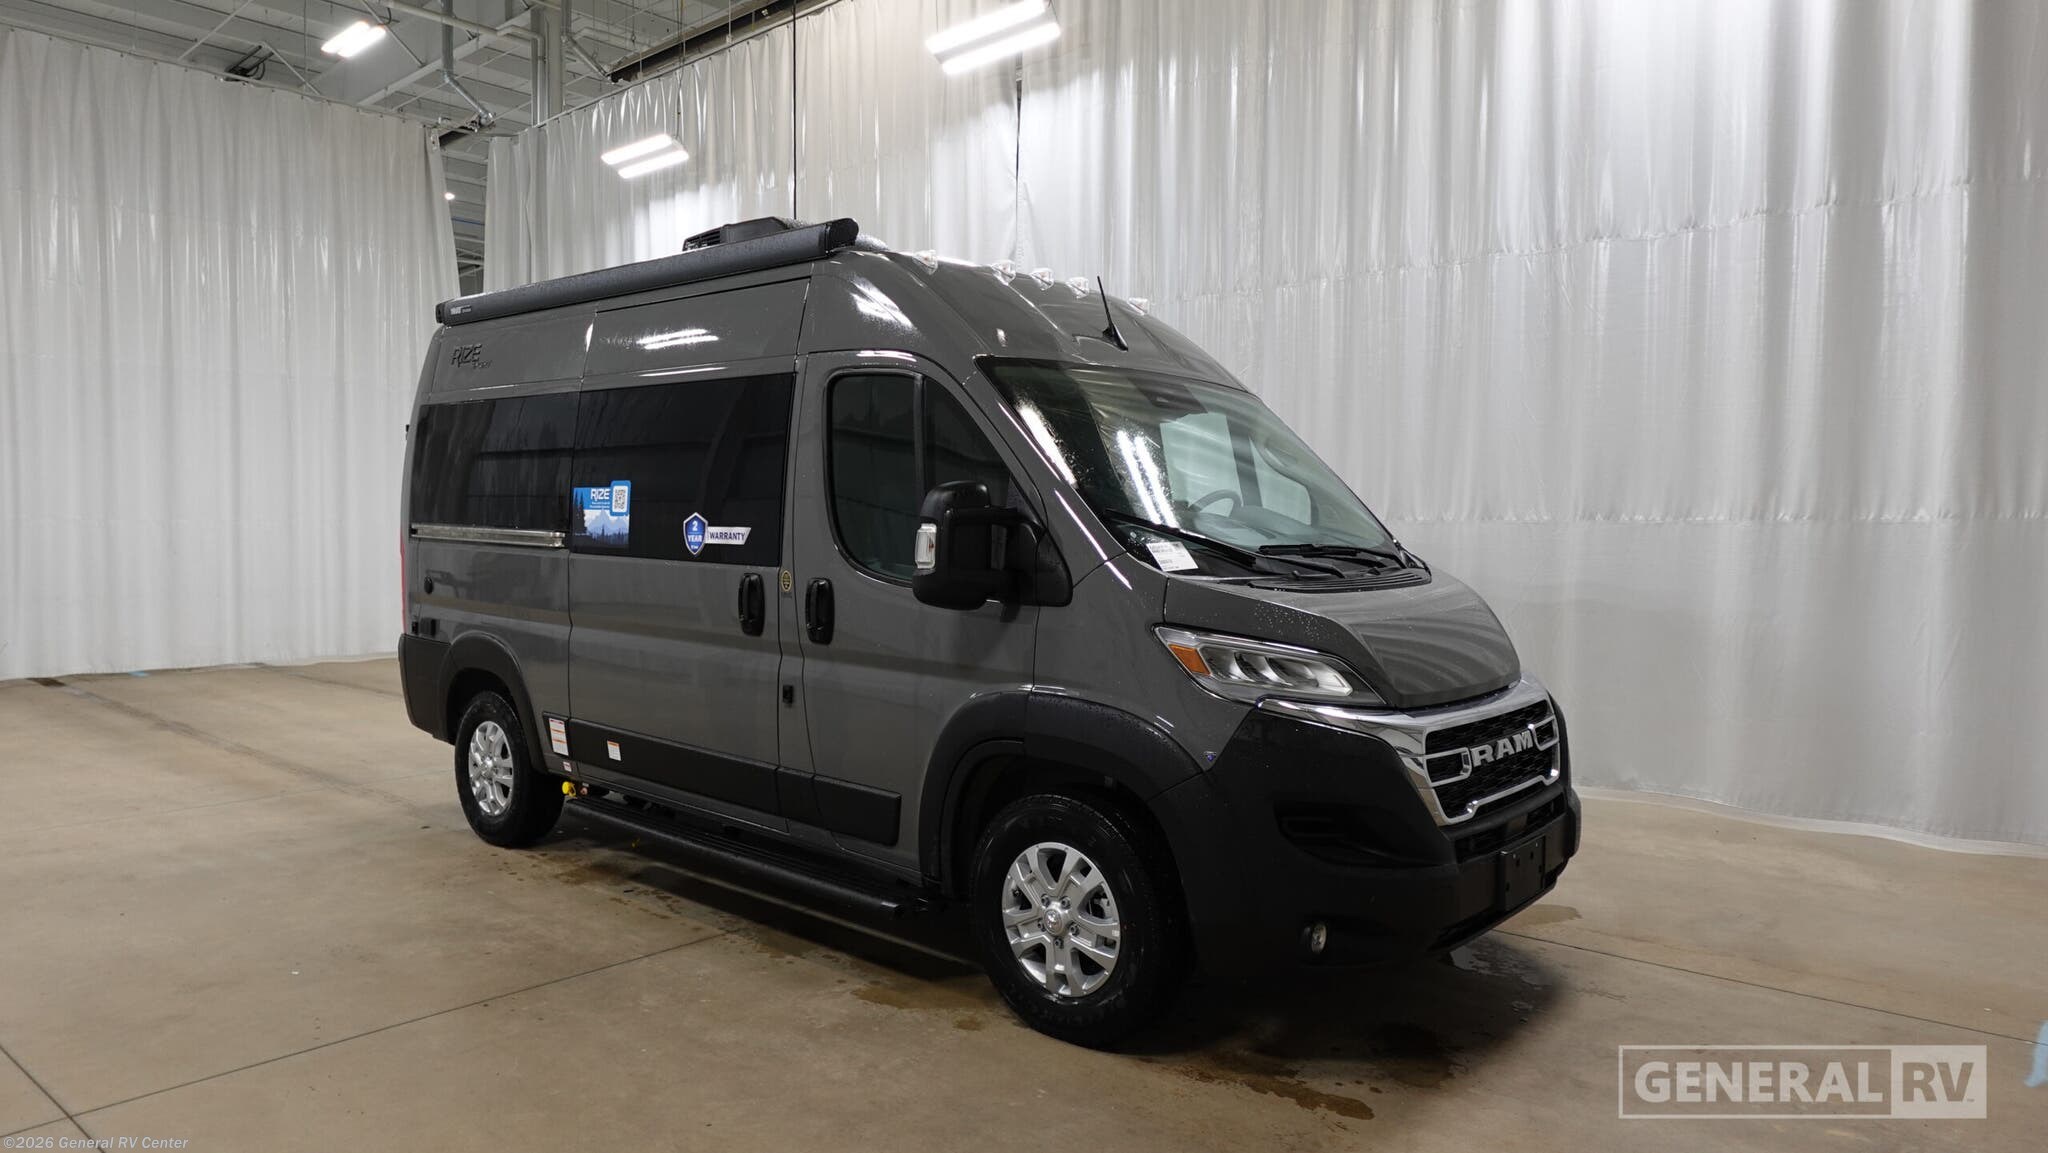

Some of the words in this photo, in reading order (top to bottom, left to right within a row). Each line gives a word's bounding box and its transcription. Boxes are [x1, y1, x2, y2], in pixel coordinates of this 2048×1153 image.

[590, 488, 611, 502] RIZE
[691, 520, 699, 532] 2
[687, 534, 703, 543] YEAR
[709, 531, 745, 541] WARRANTY
[1471, 730, 1533, 767] RAM
